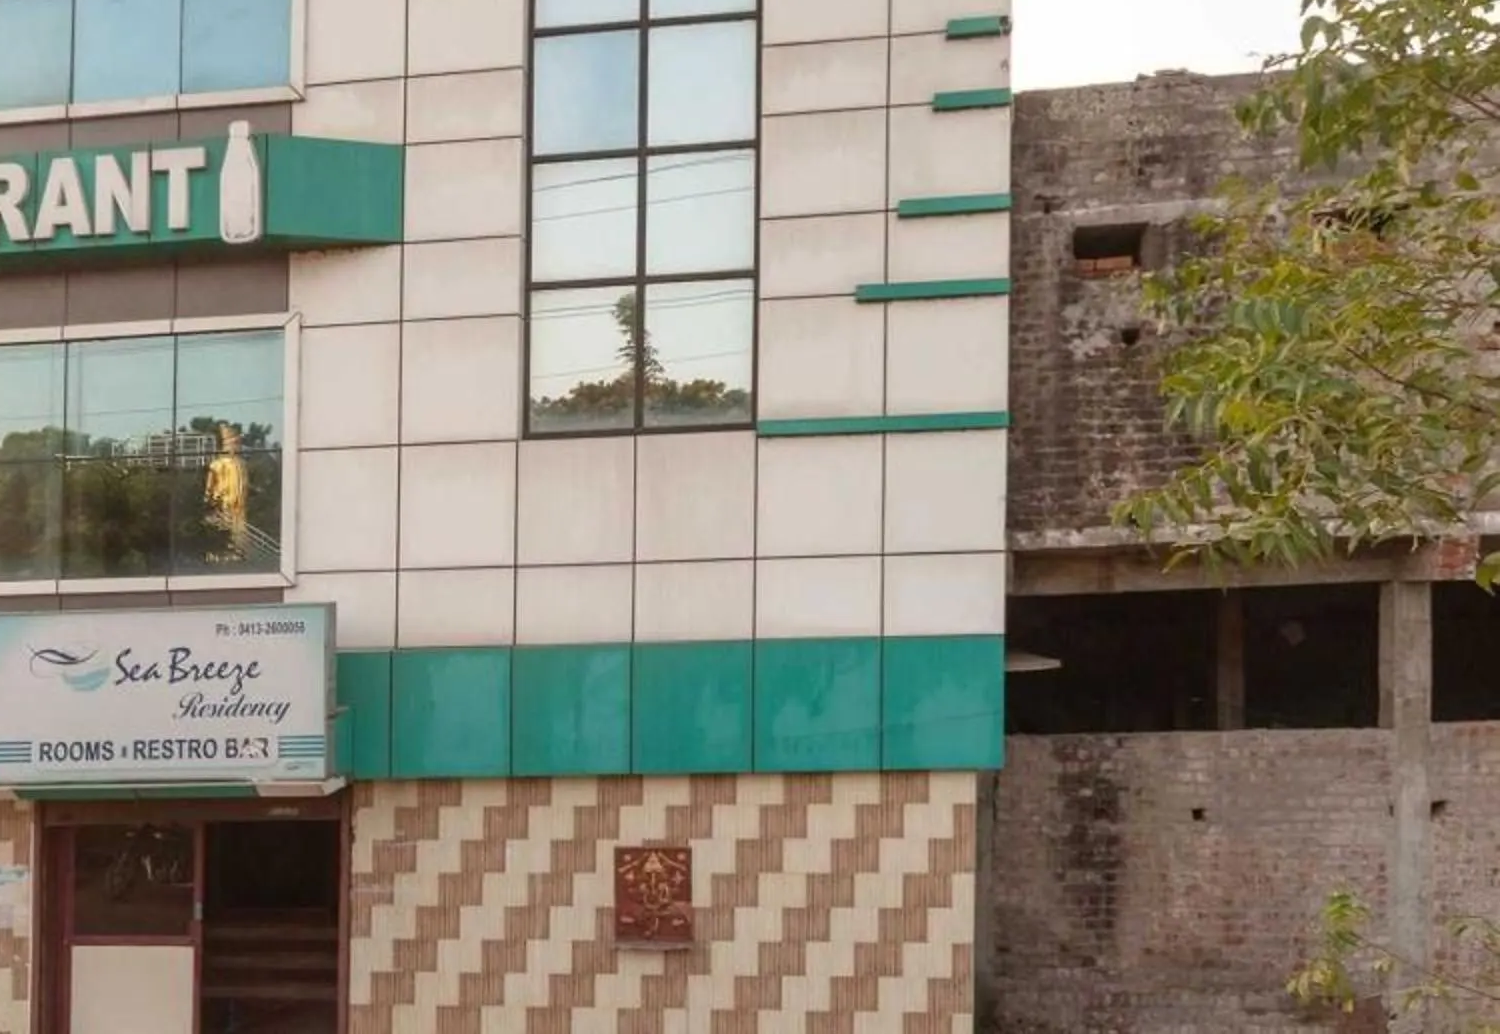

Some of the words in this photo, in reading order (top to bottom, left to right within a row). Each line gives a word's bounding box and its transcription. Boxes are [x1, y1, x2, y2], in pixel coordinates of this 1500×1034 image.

[115, 647, 161, 686] Sea
[168, 647, 262, 694] Breeze
[172, 693, 291, 724] Residency
[39, 740, 115, 762] ROOMS
[132, 738, 218, 760] RESTRO
